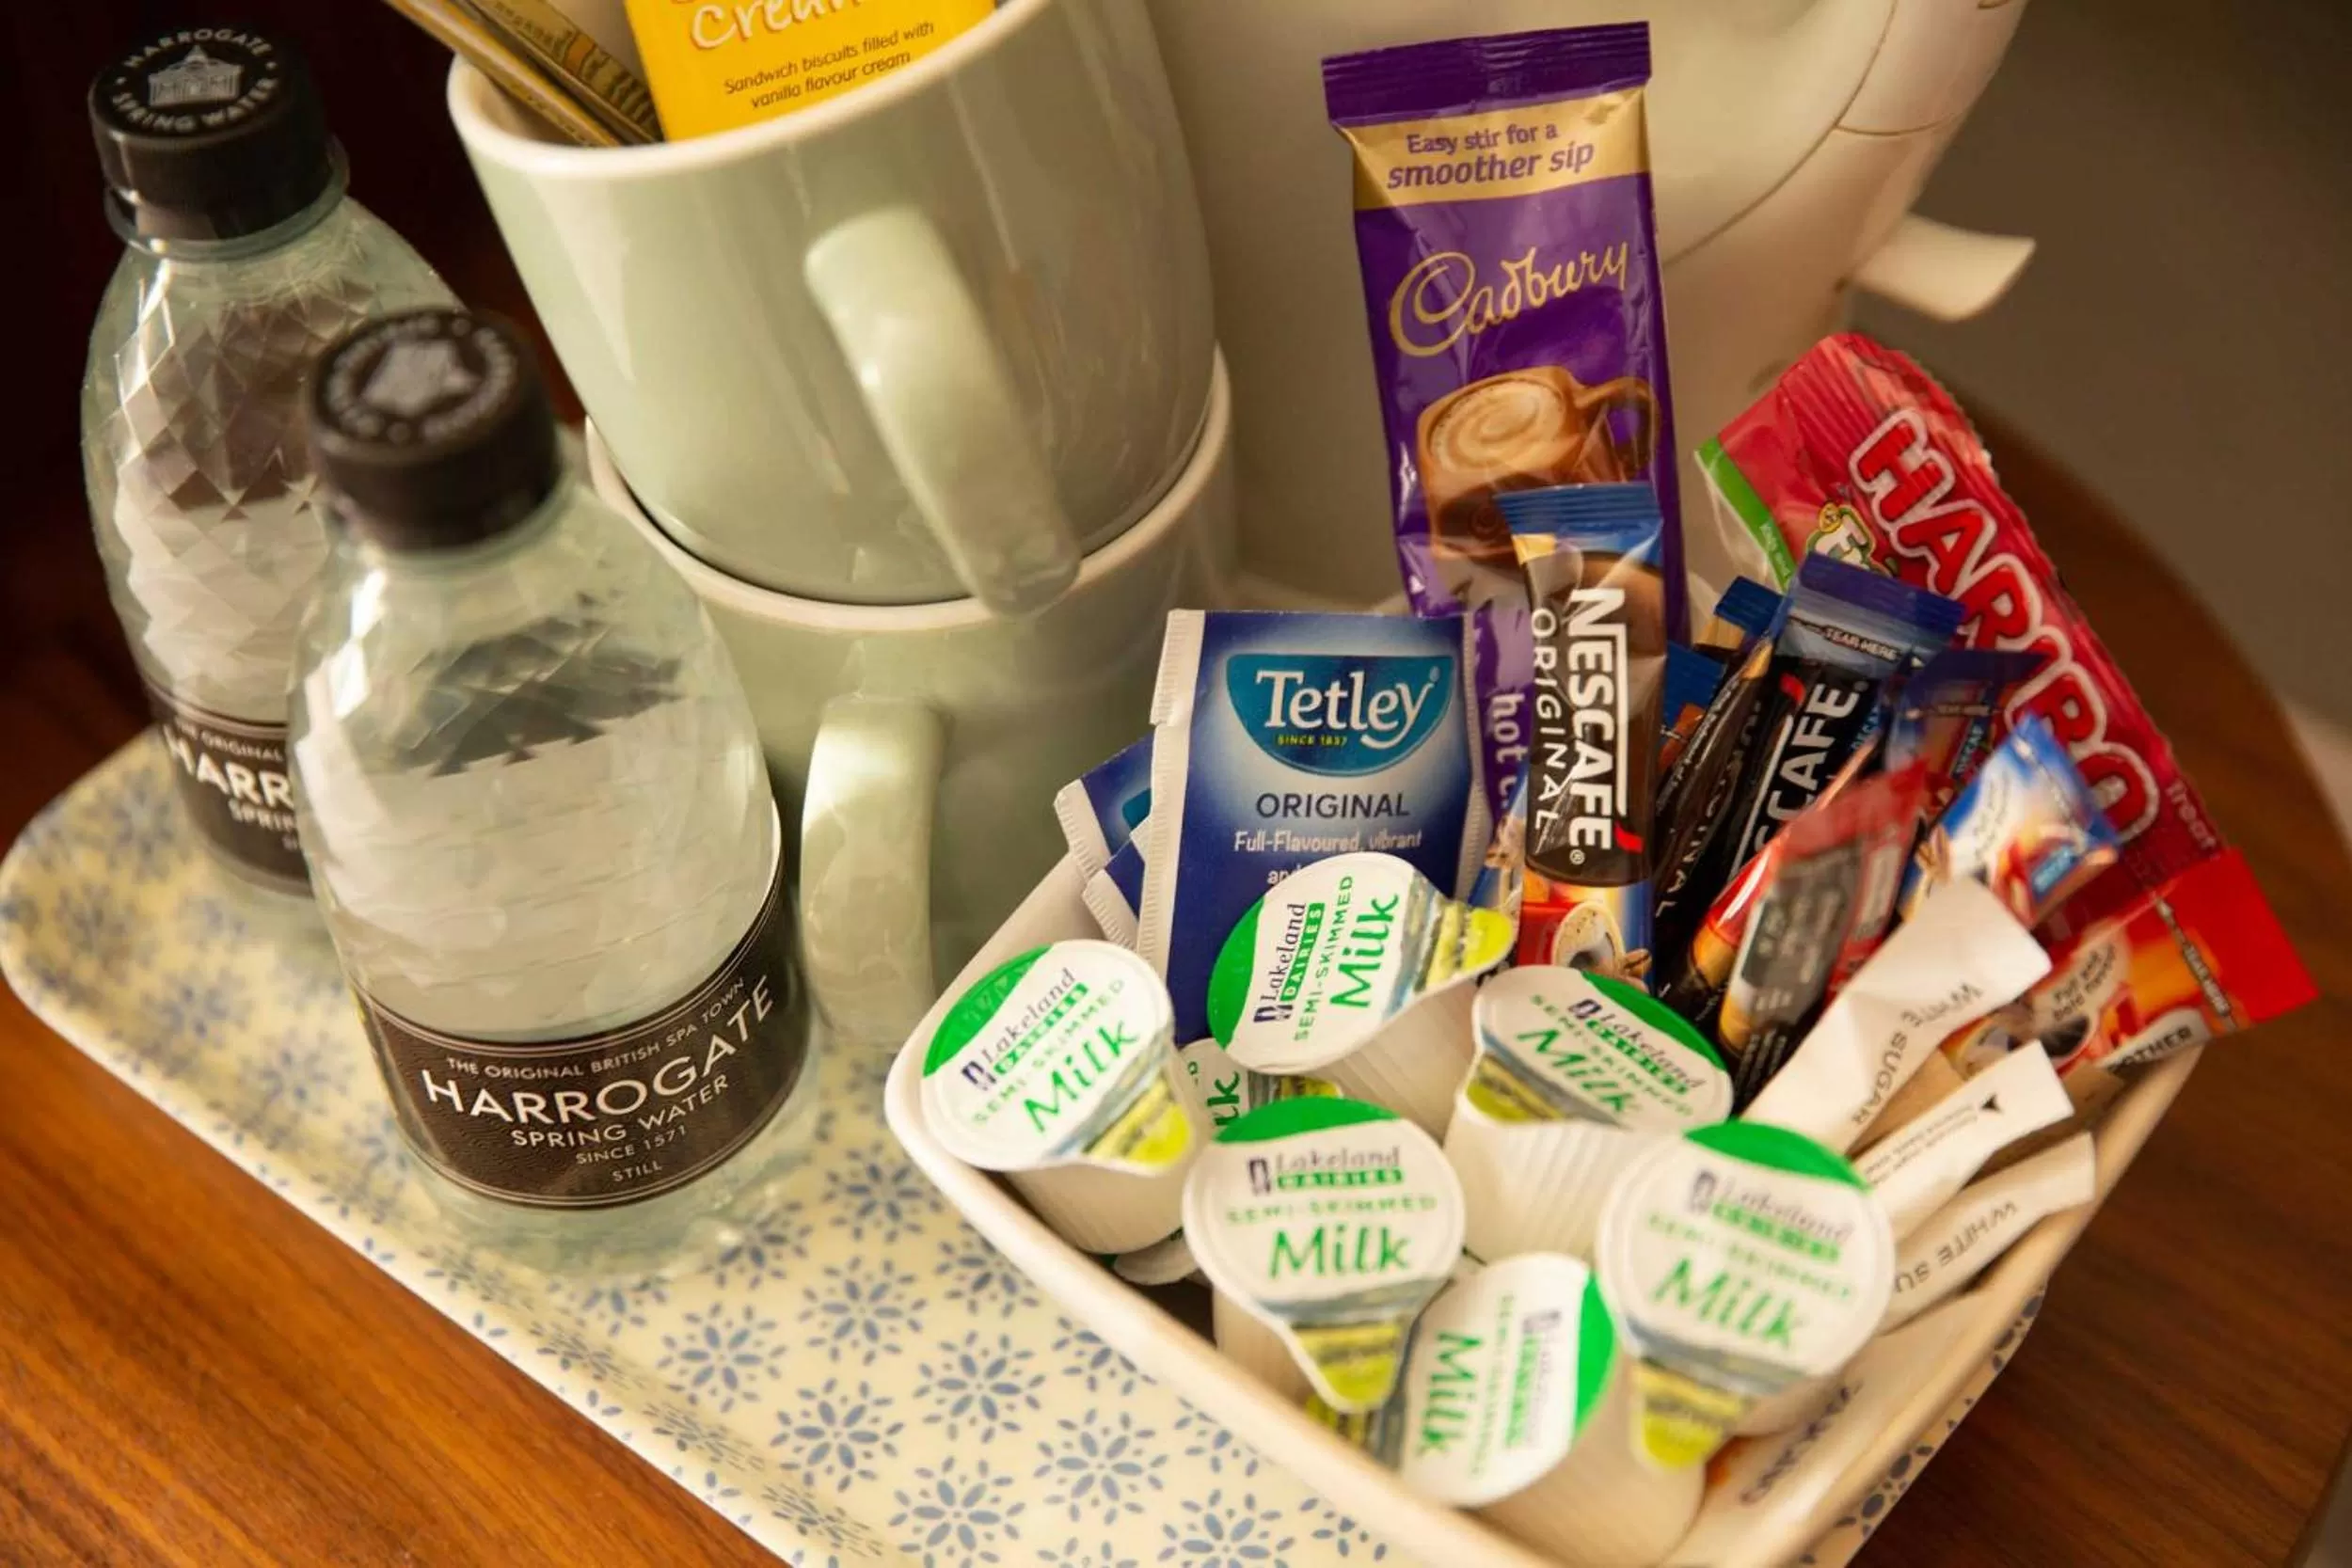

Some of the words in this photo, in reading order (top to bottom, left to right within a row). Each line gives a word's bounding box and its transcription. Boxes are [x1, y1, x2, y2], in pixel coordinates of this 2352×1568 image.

[122, 28, 272, 68] HARROGATE
[723, 61, 800, 95] Sandwich
[802, 43, 859, 72] biscuits
[862, 31, 899, 54] filled
[902, 20, 935, 41] with
[751, 83, 802, 109] vanilla
[805, 67, 858, 92] flavour
[862, 51, 912, 76] cream
[112, 92, 197, 133] SPRING
[1406, 134, 1458, 156] Easy
[1464, 129, 1501, 150] stir
[1506, 123, 1538, 146] for
[1545, 123, 1559, 139] a
[1387, 152, 1543, 190] smoother
[1549, 140, 1595, 175] sip
[1389, 241, 1629, 357] Cadbury
[1849, 409, 2161, 847] HARBO
[1255, 669, 1435, 750] Tetley
[1277, 735, 1315, 747] SINCE
[1489, 691, 1526, 764] hot
[1530, 607, 1569, 831] ORIGINAL
[163, 723, 294, 810] HARR
[1233, 829, 1364, 853] Full-Flavoured,
[1368, 827, 1422, 849] vibrant
[1256, 793, 1411, 819] ORIGINAL
[1260, 903, 1306, 1003] Lakeland
[1280, 902, 1326, 1001] DAIRIES
[1294, 876, 1354, 1041] SEMI-SKIMMED
[1329, 894, 1400, 1008] Milk
[421, 974, 775, 1126] HARROGATE
[446, 1057, 479, 1077] THE
[484, 1063, 585, 1081] ORIGINAL
[590, 1042, 660, 1074] BRITISH
[664, 1023, 698, 1049] SPA
[700, 977, 745, 1025] TOWN
[981, 966, 1076, 1065] Lakeland
[1024, 1019, 1139, 1133] Milk
[1207, 1070, 1241, 1126] lk
[1517, 1029, 1643, 1113] Milk
[1851, 1031, 1909, 1128] SUGAR
[510, 1123, 628, 1149] SPRING
[638, 1073, 730, 1132] WATER
[575, 1143, 636, 1165] SINCE
[644, 1124, 688, 1152] 1571
[612, 1160, 663, 1182] STILL
[1276, 1146, 1401, 1172] Lakeland
[1270, 1225, 1411, 1280] Milk
[1937, 1198, 2019, 1267] WHITE
[1653, 1257, 1810, 1349] Milk
[1893, 1261, 1931, 1294] SU
[1416, 1332, 1481, 1458] Milk
